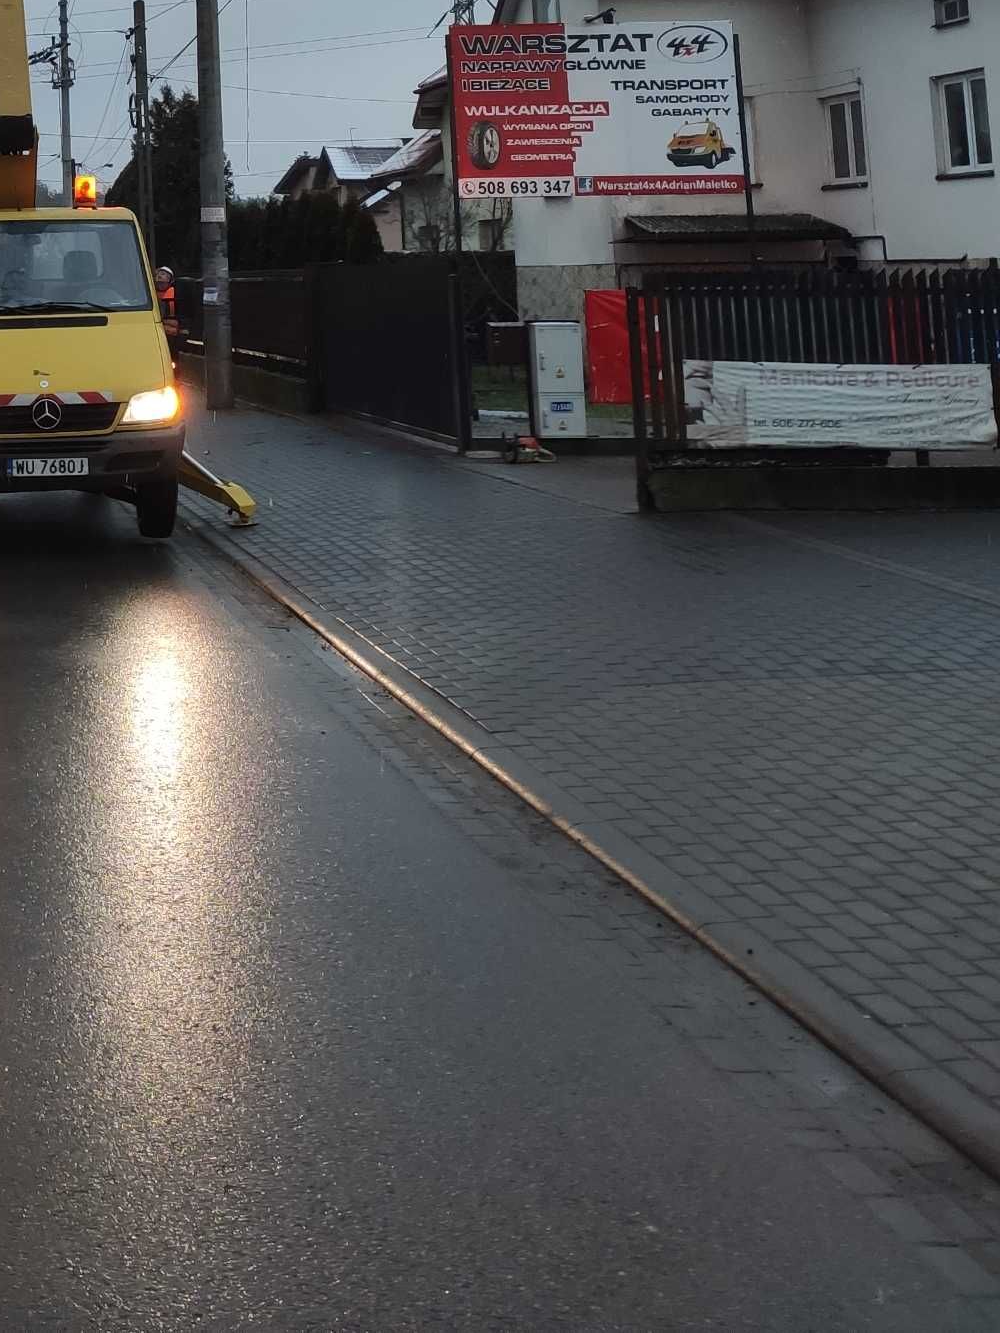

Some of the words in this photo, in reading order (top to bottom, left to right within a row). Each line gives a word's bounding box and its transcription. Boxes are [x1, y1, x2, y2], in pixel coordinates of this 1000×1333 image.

[460, 33, 653, 55] WARSZTAT
[666, 33, 719, 58] 4x4
[461, 60, 561, 73] NAPRAWY
[563, 57, 646, 71] GŁÓWNE
[611, 79, 728, 91] TRANSPORT
[635, 95, 729, 104] SAMOCHODY
[464, 104, 607, 116] WULKANIZACJA
[651, 108, 731, 117] GABARYTY
[502, 123, 557, 131] WYMIANA
[559, 122, 591, 130] OPON
[506, 137, 580, 146] ZAWIESZENIA
[511, 153, 573, 162] GEOMETRIA
[478, 181, 505, 195] 508
[510, 180, 538, 194] 693
[543, 180, 571, 194] 347
[760, 369, 858, 386] Manicure
[886, 371, 980, 387] Pedicure
[16, 460, 35, 474] WU
[40, 459, 84, 474] 7680J
